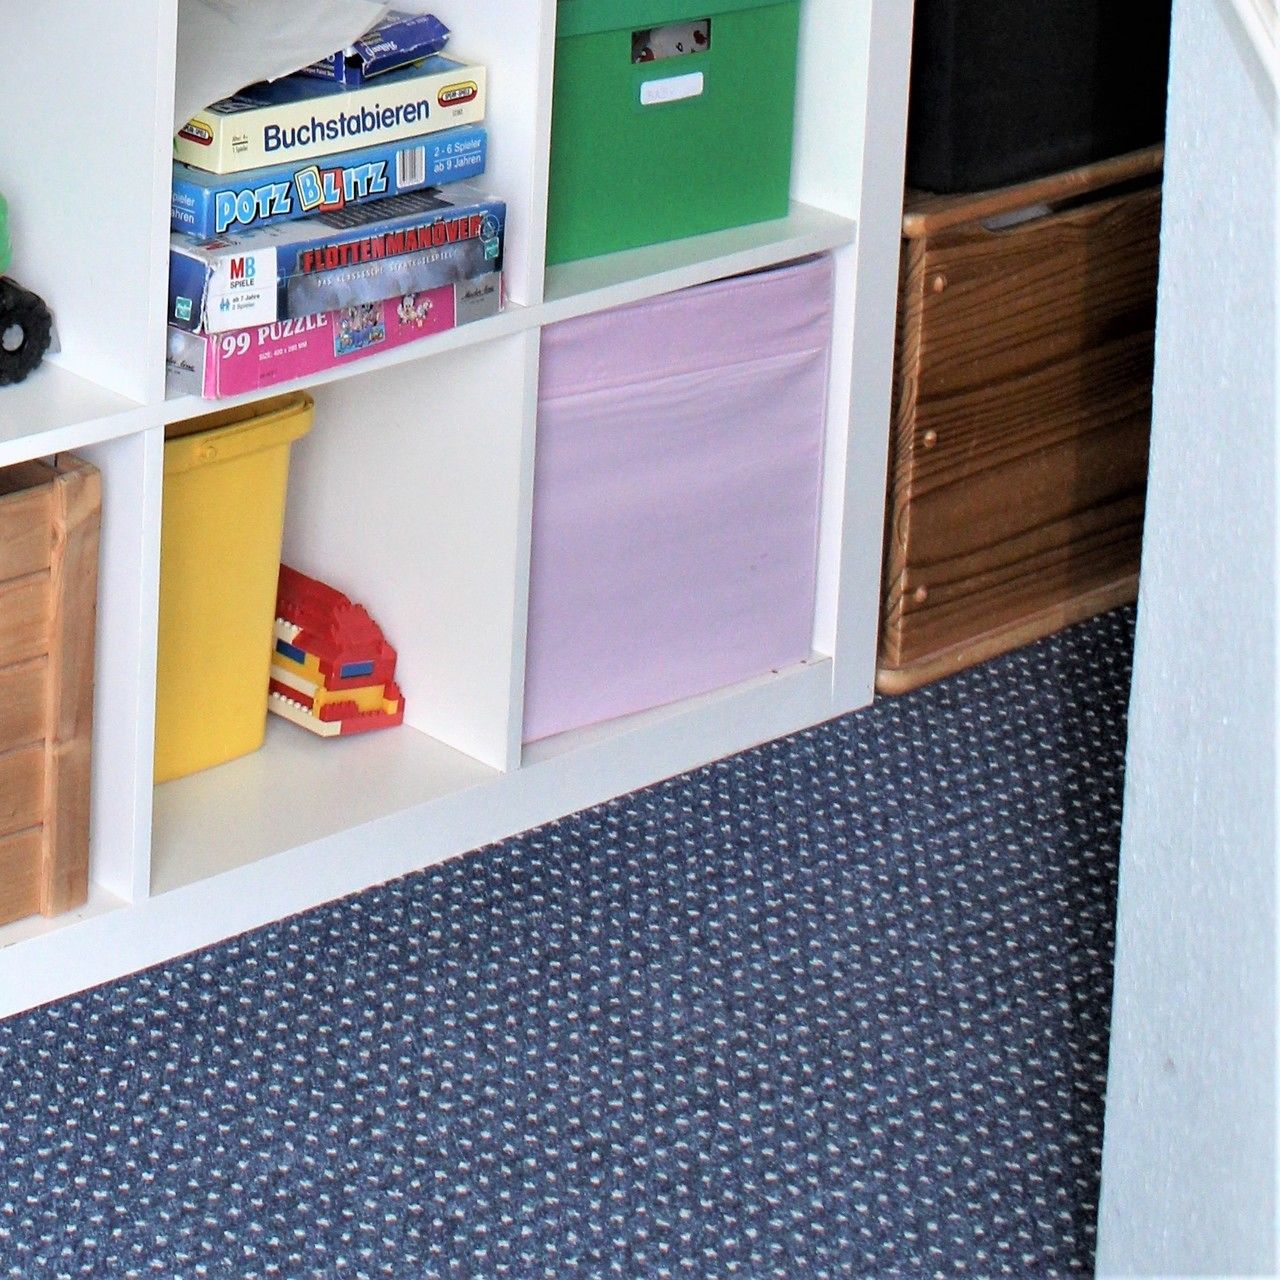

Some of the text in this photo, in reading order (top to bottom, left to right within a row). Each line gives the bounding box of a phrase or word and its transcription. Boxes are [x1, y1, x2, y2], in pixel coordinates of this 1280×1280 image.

[264, 97, 430, 152] Buchstabieren
[434, 140, 482, 157] 2 6 Spieler
[446, 154, 481, 170] 9 Jahren
[215, 159, 387, 233] POTZ BLITZ
[302, 212, 484, 273] FLOTTENMANÖVER
[230, 256, 256, 280] MB
[230, 279, 255, 289] SPIELE
[222, 311, 328, 359] 99 PUZZLE
